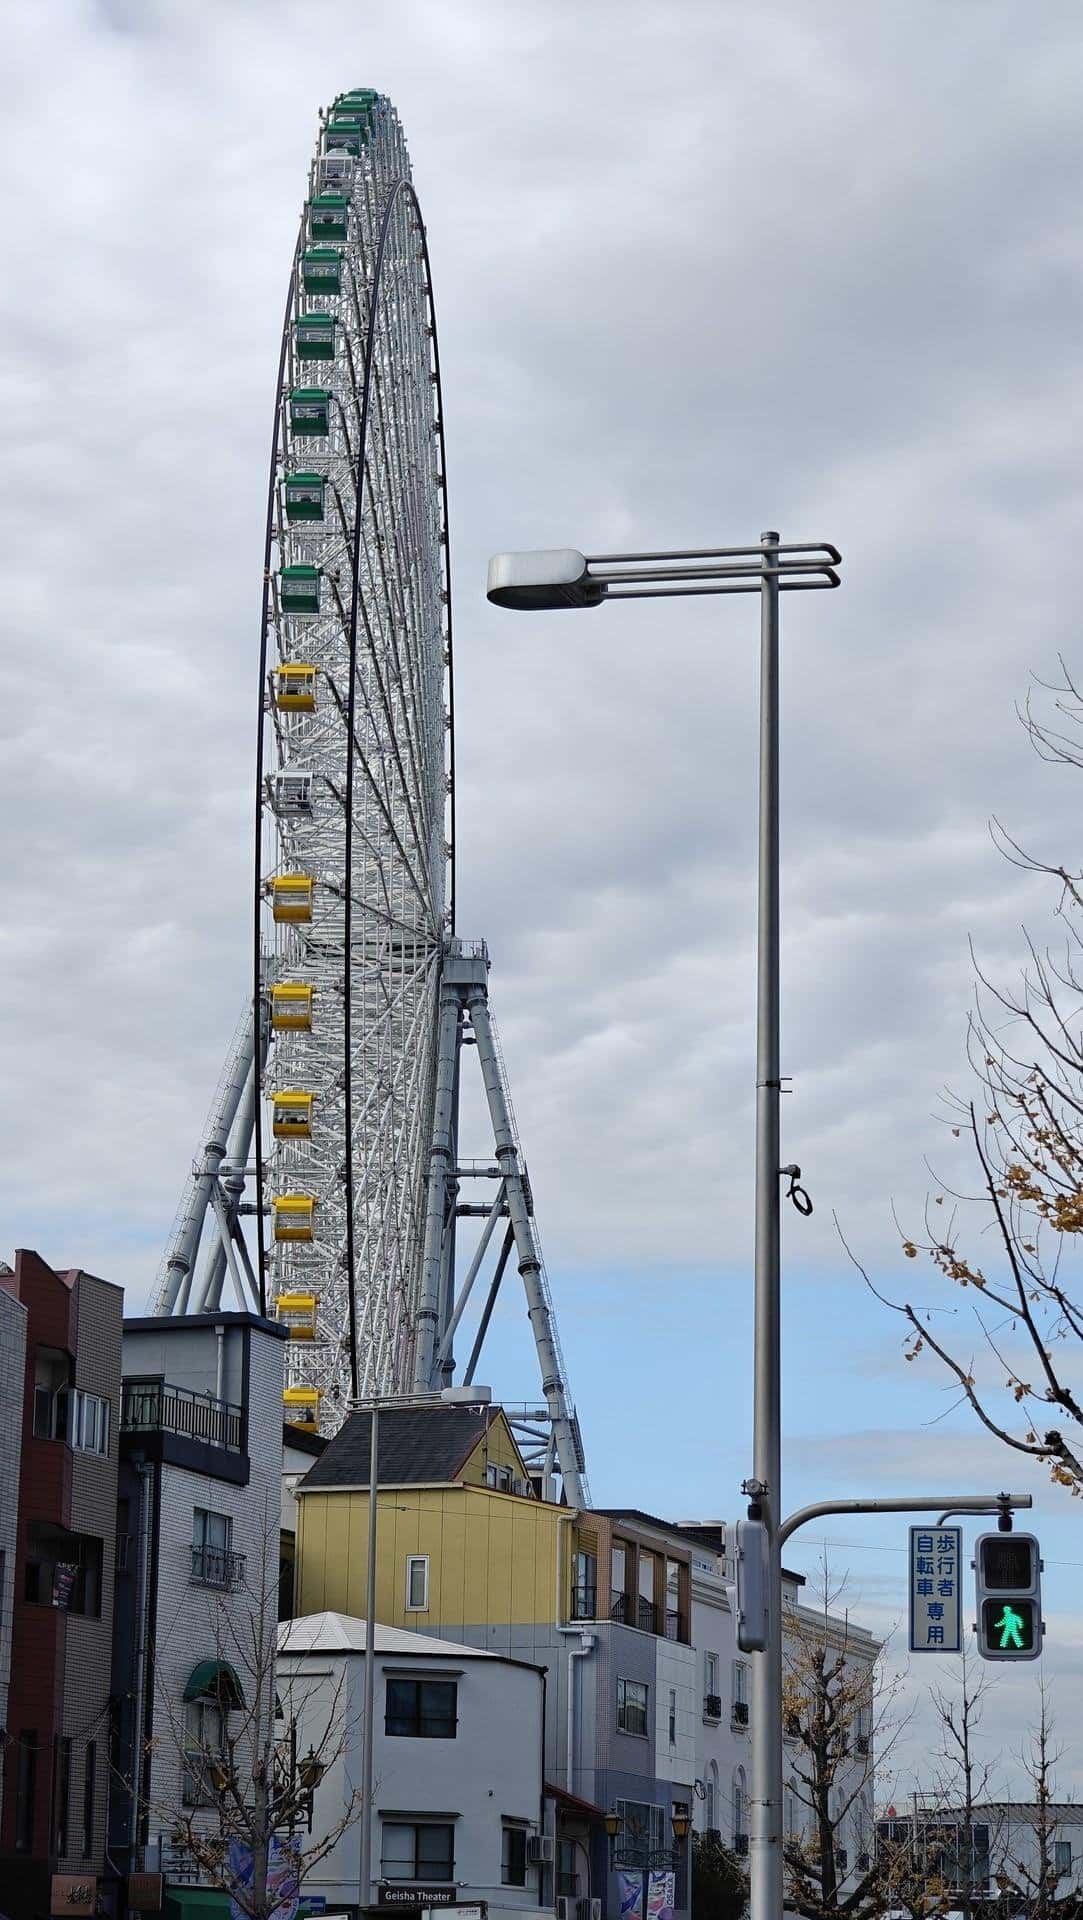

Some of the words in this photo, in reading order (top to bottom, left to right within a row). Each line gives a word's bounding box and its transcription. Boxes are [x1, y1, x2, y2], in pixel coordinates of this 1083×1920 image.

[916, 1534, 934, 1597] 自転車
[937, 1534, 955, 1597] 歩行者
[926, 1601, 945, 1644] 専用
[385, 1891, 415, 1900] Geisha
[417, 1892, 451, 1901] Theater
